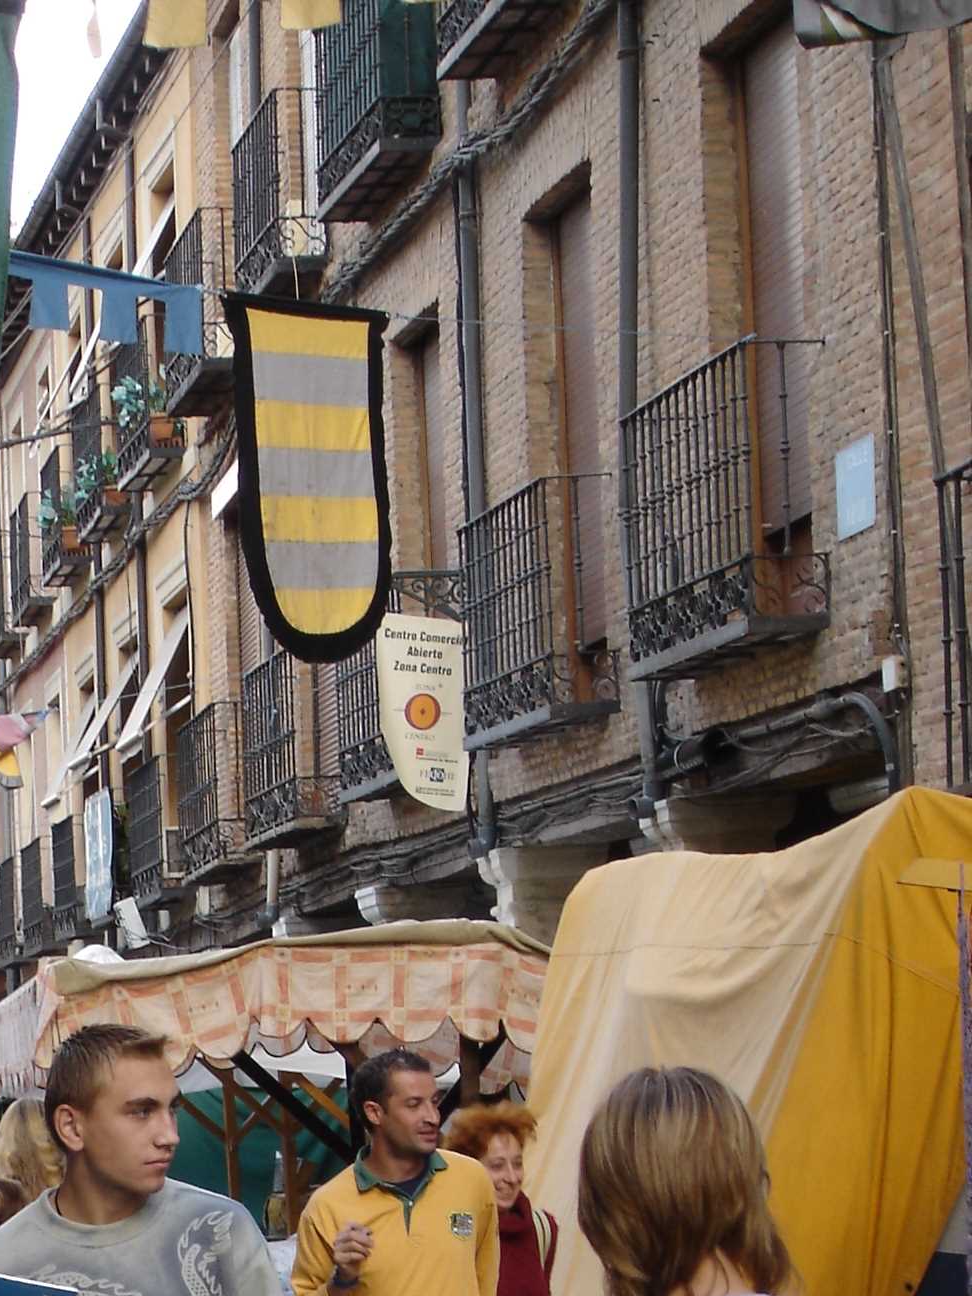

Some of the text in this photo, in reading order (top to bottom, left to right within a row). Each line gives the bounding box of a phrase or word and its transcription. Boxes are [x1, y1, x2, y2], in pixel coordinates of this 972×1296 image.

[384, 627, 417, 640] Centro
[407, 646, 443, 659] Abierto
[394, 660, 452, 676] Zona Centro
